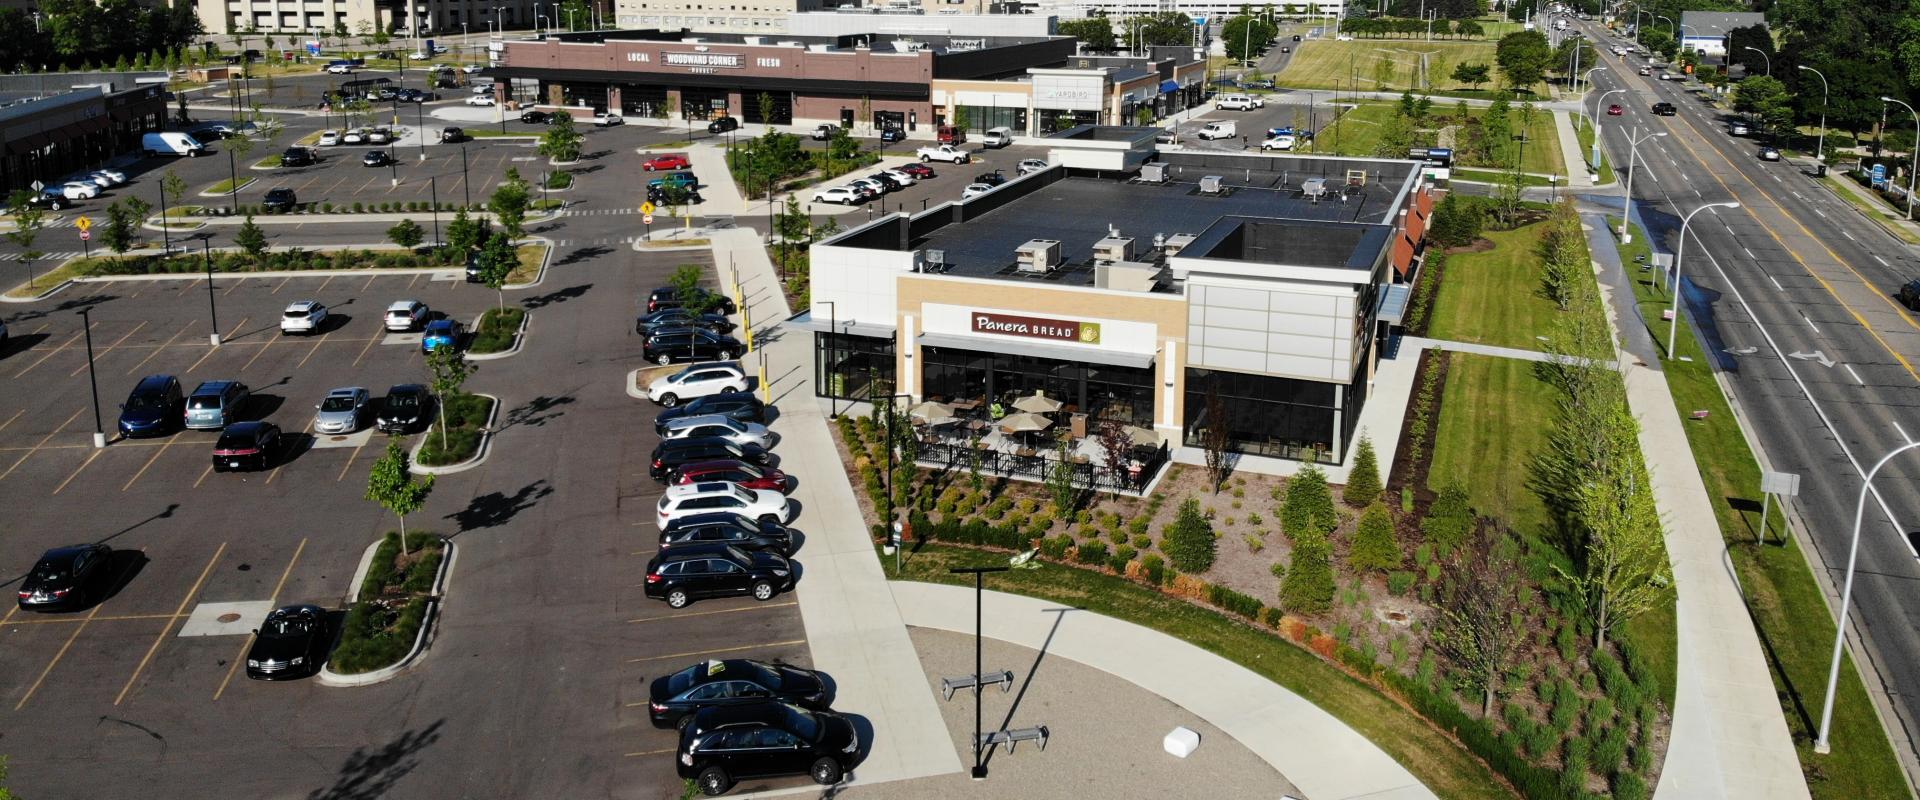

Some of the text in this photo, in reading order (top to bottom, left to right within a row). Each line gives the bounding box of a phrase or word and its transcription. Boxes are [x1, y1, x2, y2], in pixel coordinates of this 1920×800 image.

[627, 53, 650, 62] LOCAL
[667, 54, 737, 66] WOODWARD CORNER
[757, 58, 780, 67] FRESH
[976, 316, 1071, 337] Panera BREAD
